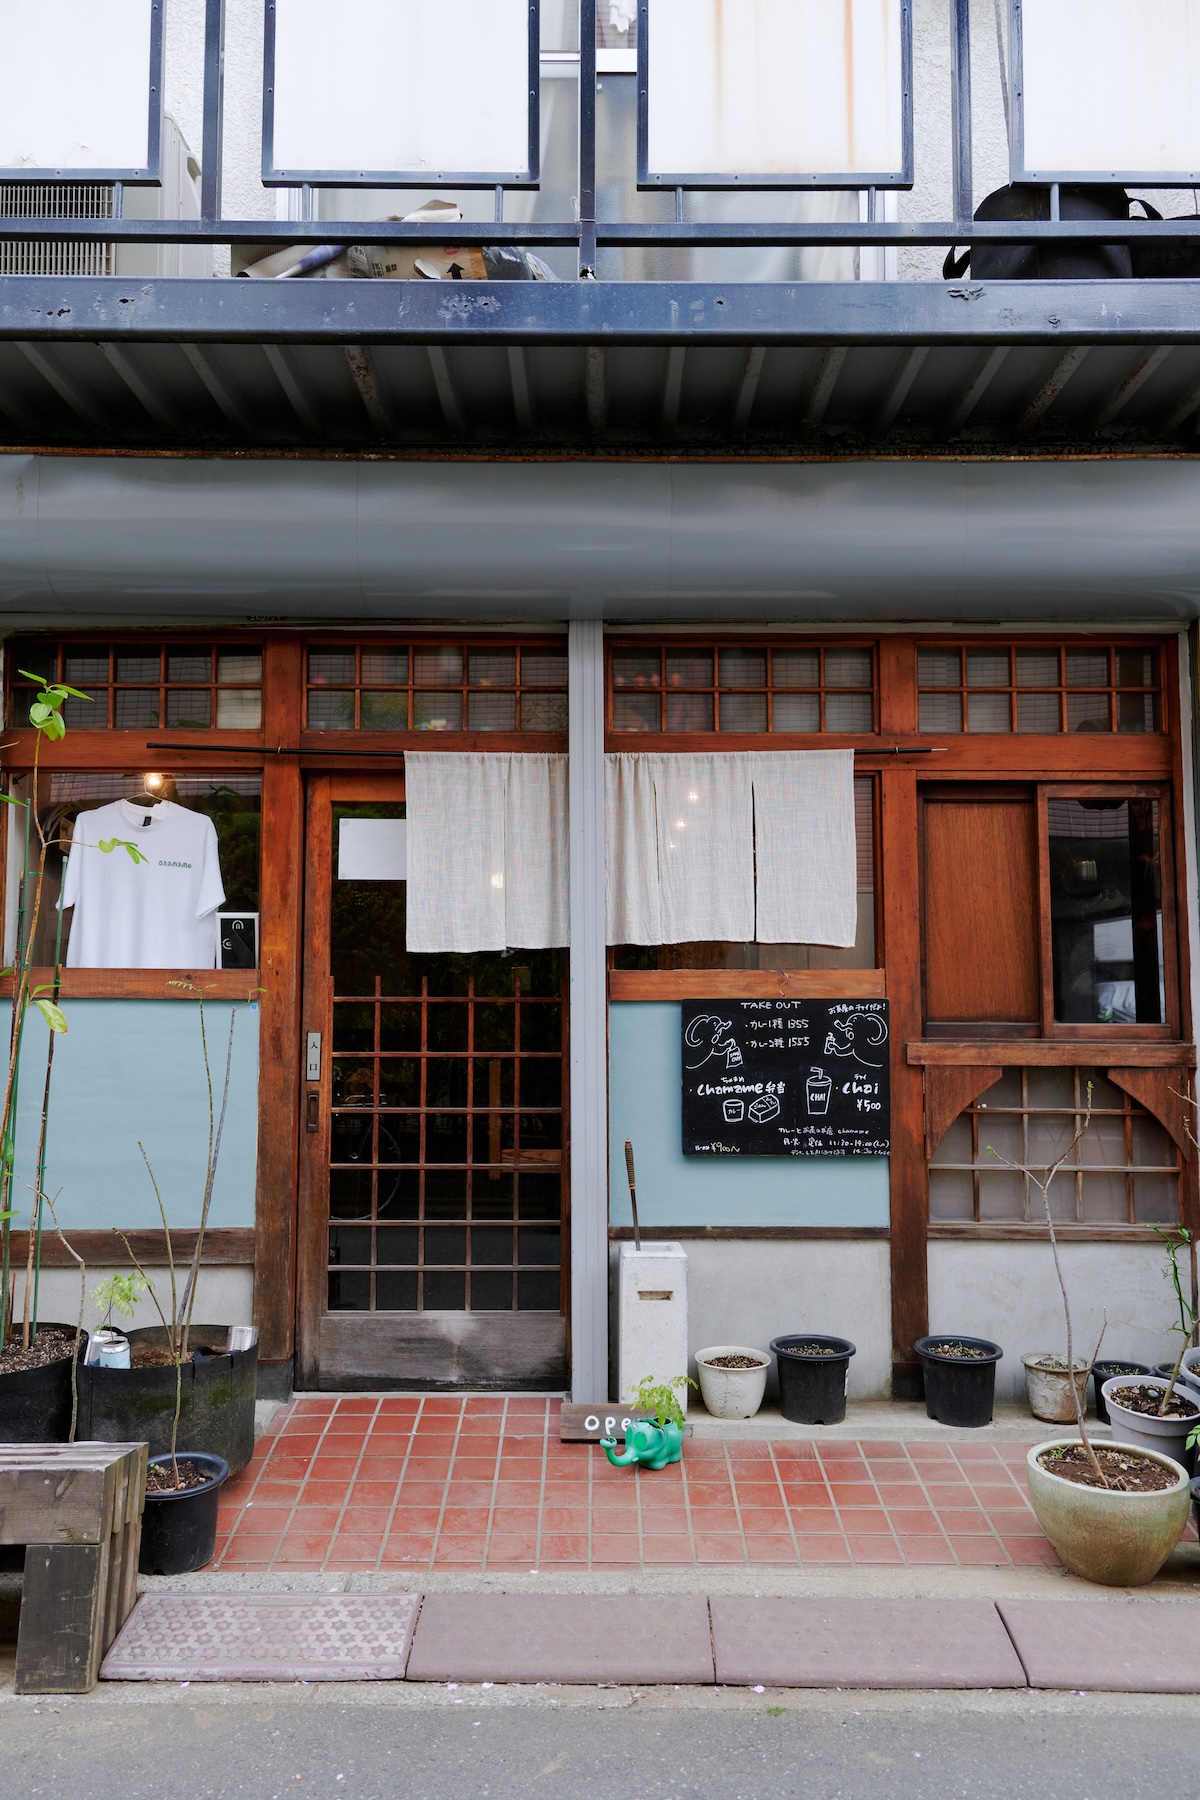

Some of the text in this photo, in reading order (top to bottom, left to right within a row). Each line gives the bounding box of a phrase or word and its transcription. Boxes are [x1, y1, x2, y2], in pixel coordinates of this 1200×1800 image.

[740, 1001, 802, 1010] TAKE OUT
[787, 1018, 810, 1029] 1355
[787, 1036, 810, 1047] 1555
[810, 1092, 826, 1101] CHAI
[856, 1098, 881, 1112] ¥500
